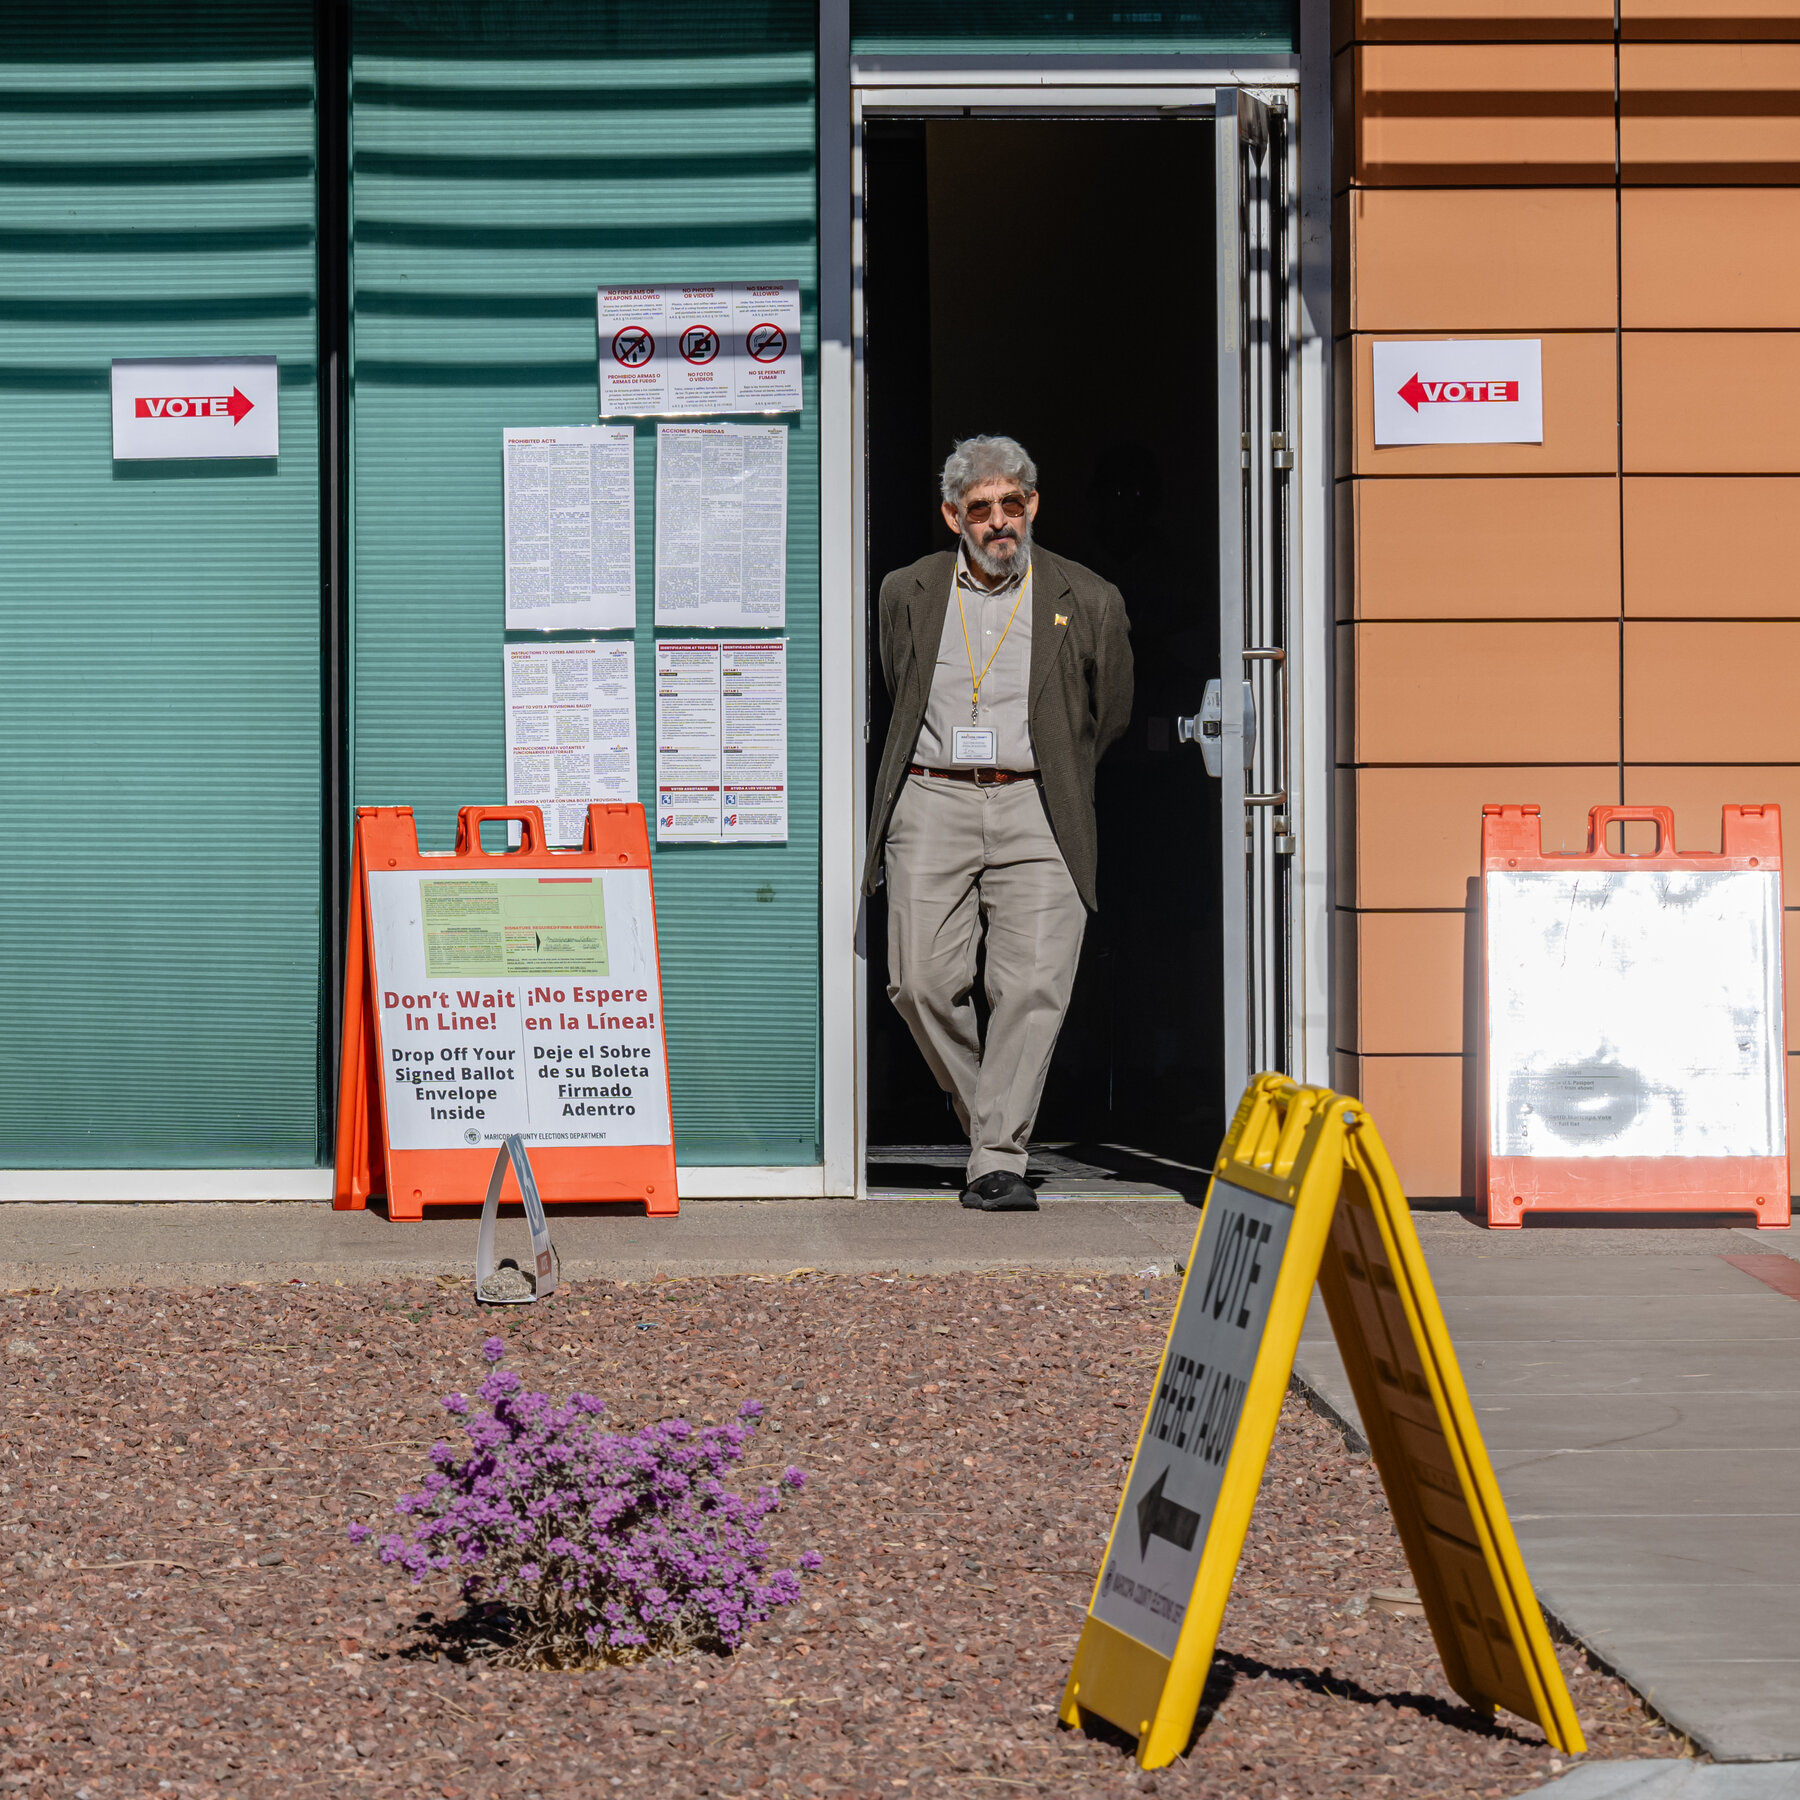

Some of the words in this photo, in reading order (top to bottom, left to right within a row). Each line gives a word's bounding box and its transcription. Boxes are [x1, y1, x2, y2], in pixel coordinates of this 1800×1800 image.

[1422, 382, 1507, 402] VOTE
[145, 398, 228, 416] VOTE
[384, 990, 450, 1008] Don't
[456, 990, 516, 1008] Wait
[528, 986, 566, 1006] ¡No
[573, 986, 648, 1008] Espere
[406, 1013, 429, 1030] In
[438, 1012, 496, 1030] Line!
[525, 1017, 552, 1030] en
[560, 1012, 580, 1030] la
[586, 1011, 656, 1030] Línea!
[392, 1048, 434, 1066] Drop
[440, 1046, 468, 1062] Off
[472, 1047, 516, 1061] Your
[533, 1045, 572, 1062] Deje
[578, 1044, 594, 1059] el
[600, 1044, 651, 1058] Sobre
[396, 1066, 456, 1083] Signed
[461, 1066, 515, 1080] Ballot
[538, 1064, 560, 1078] de
[566, 1068, 586, 1078] su
[592, 1064, 649, 1078] Boleta
[415, 1086, 497, 1104] Envelope
[558, 1083, 632, 1098] Firmado
[430, 1106, 486, 1120] Inside
[562, 1102, 636, 1117] Adentro
[1202, 1209, 1272, 1328] VOTE
